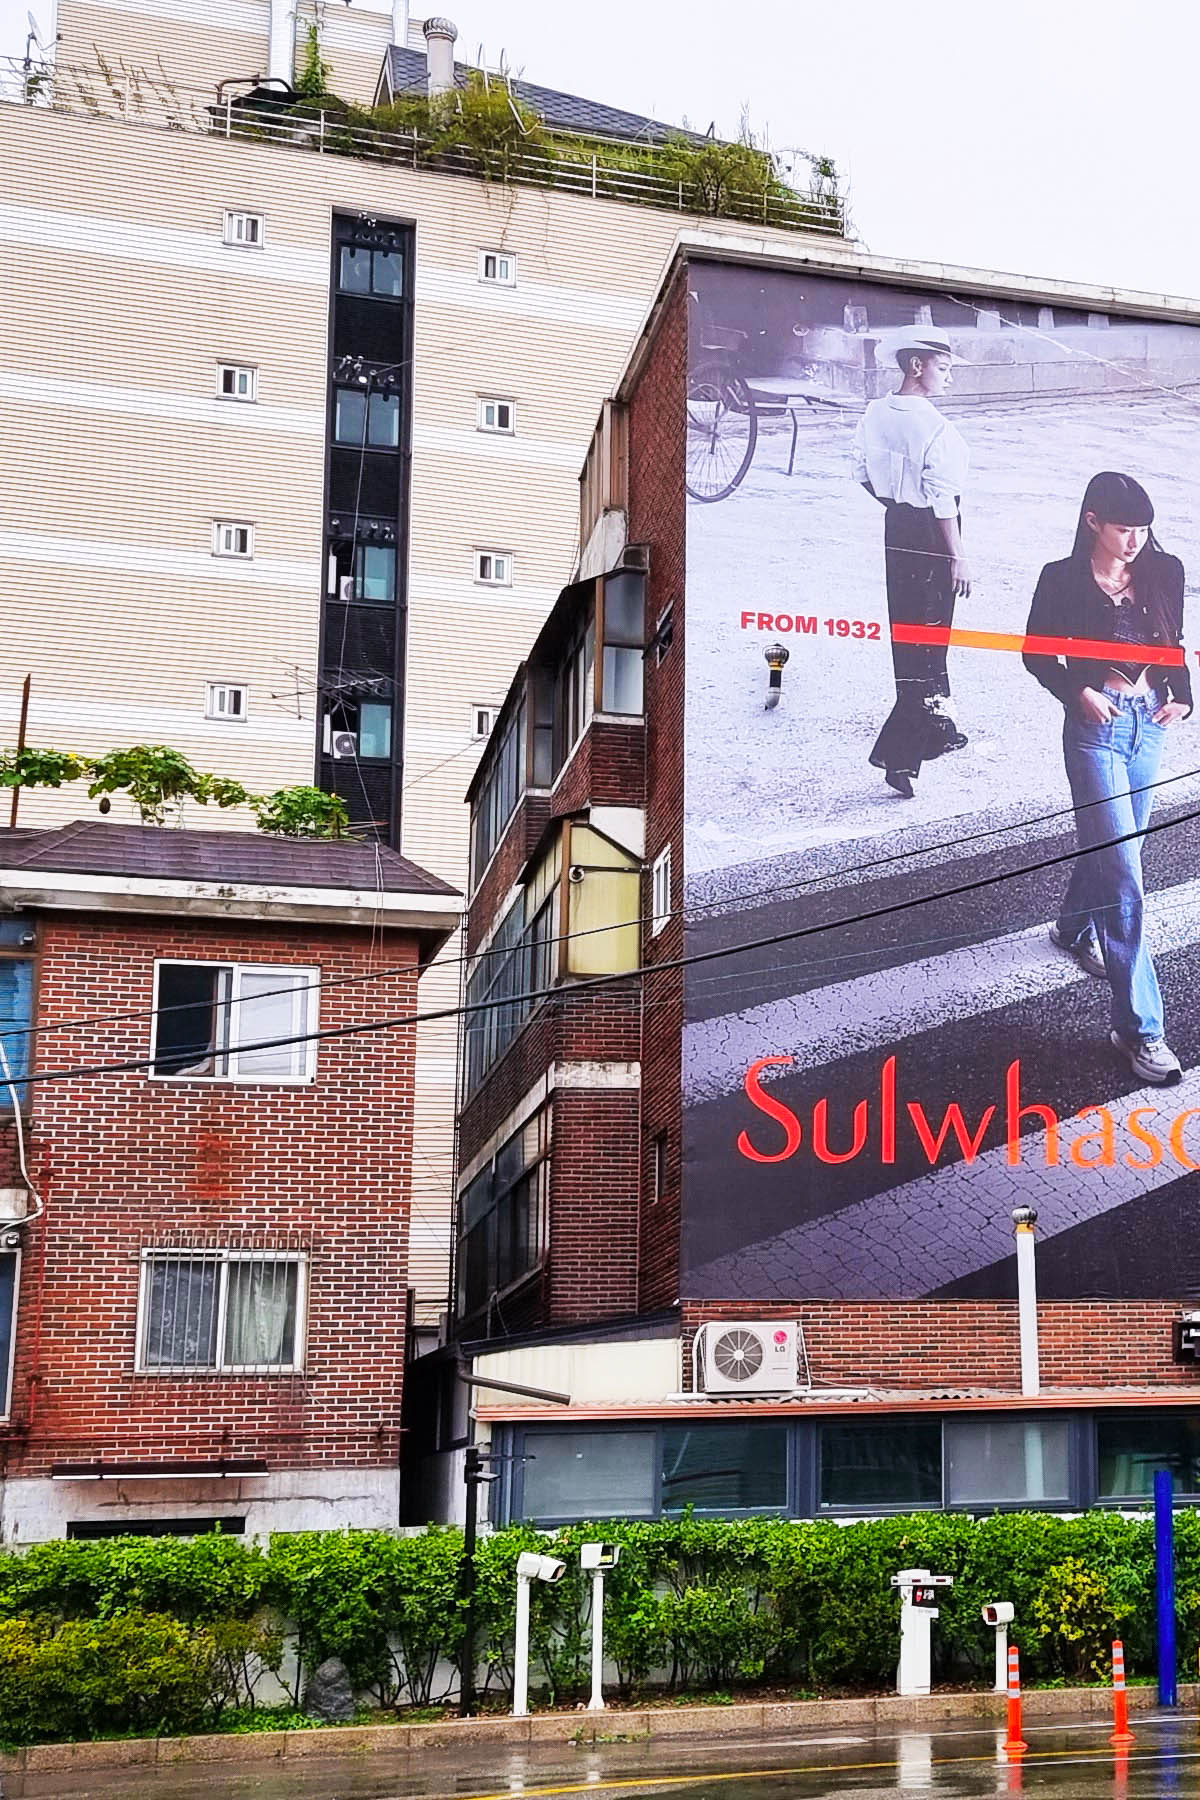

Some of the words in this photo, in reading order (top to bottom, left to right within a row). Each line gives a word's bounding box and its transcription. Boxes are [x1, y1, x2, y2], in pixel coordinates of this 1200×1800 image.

[740, 611, 818, 635] FROM
[823, 618, 881, 641] 1932
[774, 1345, 786, 1353] LG
